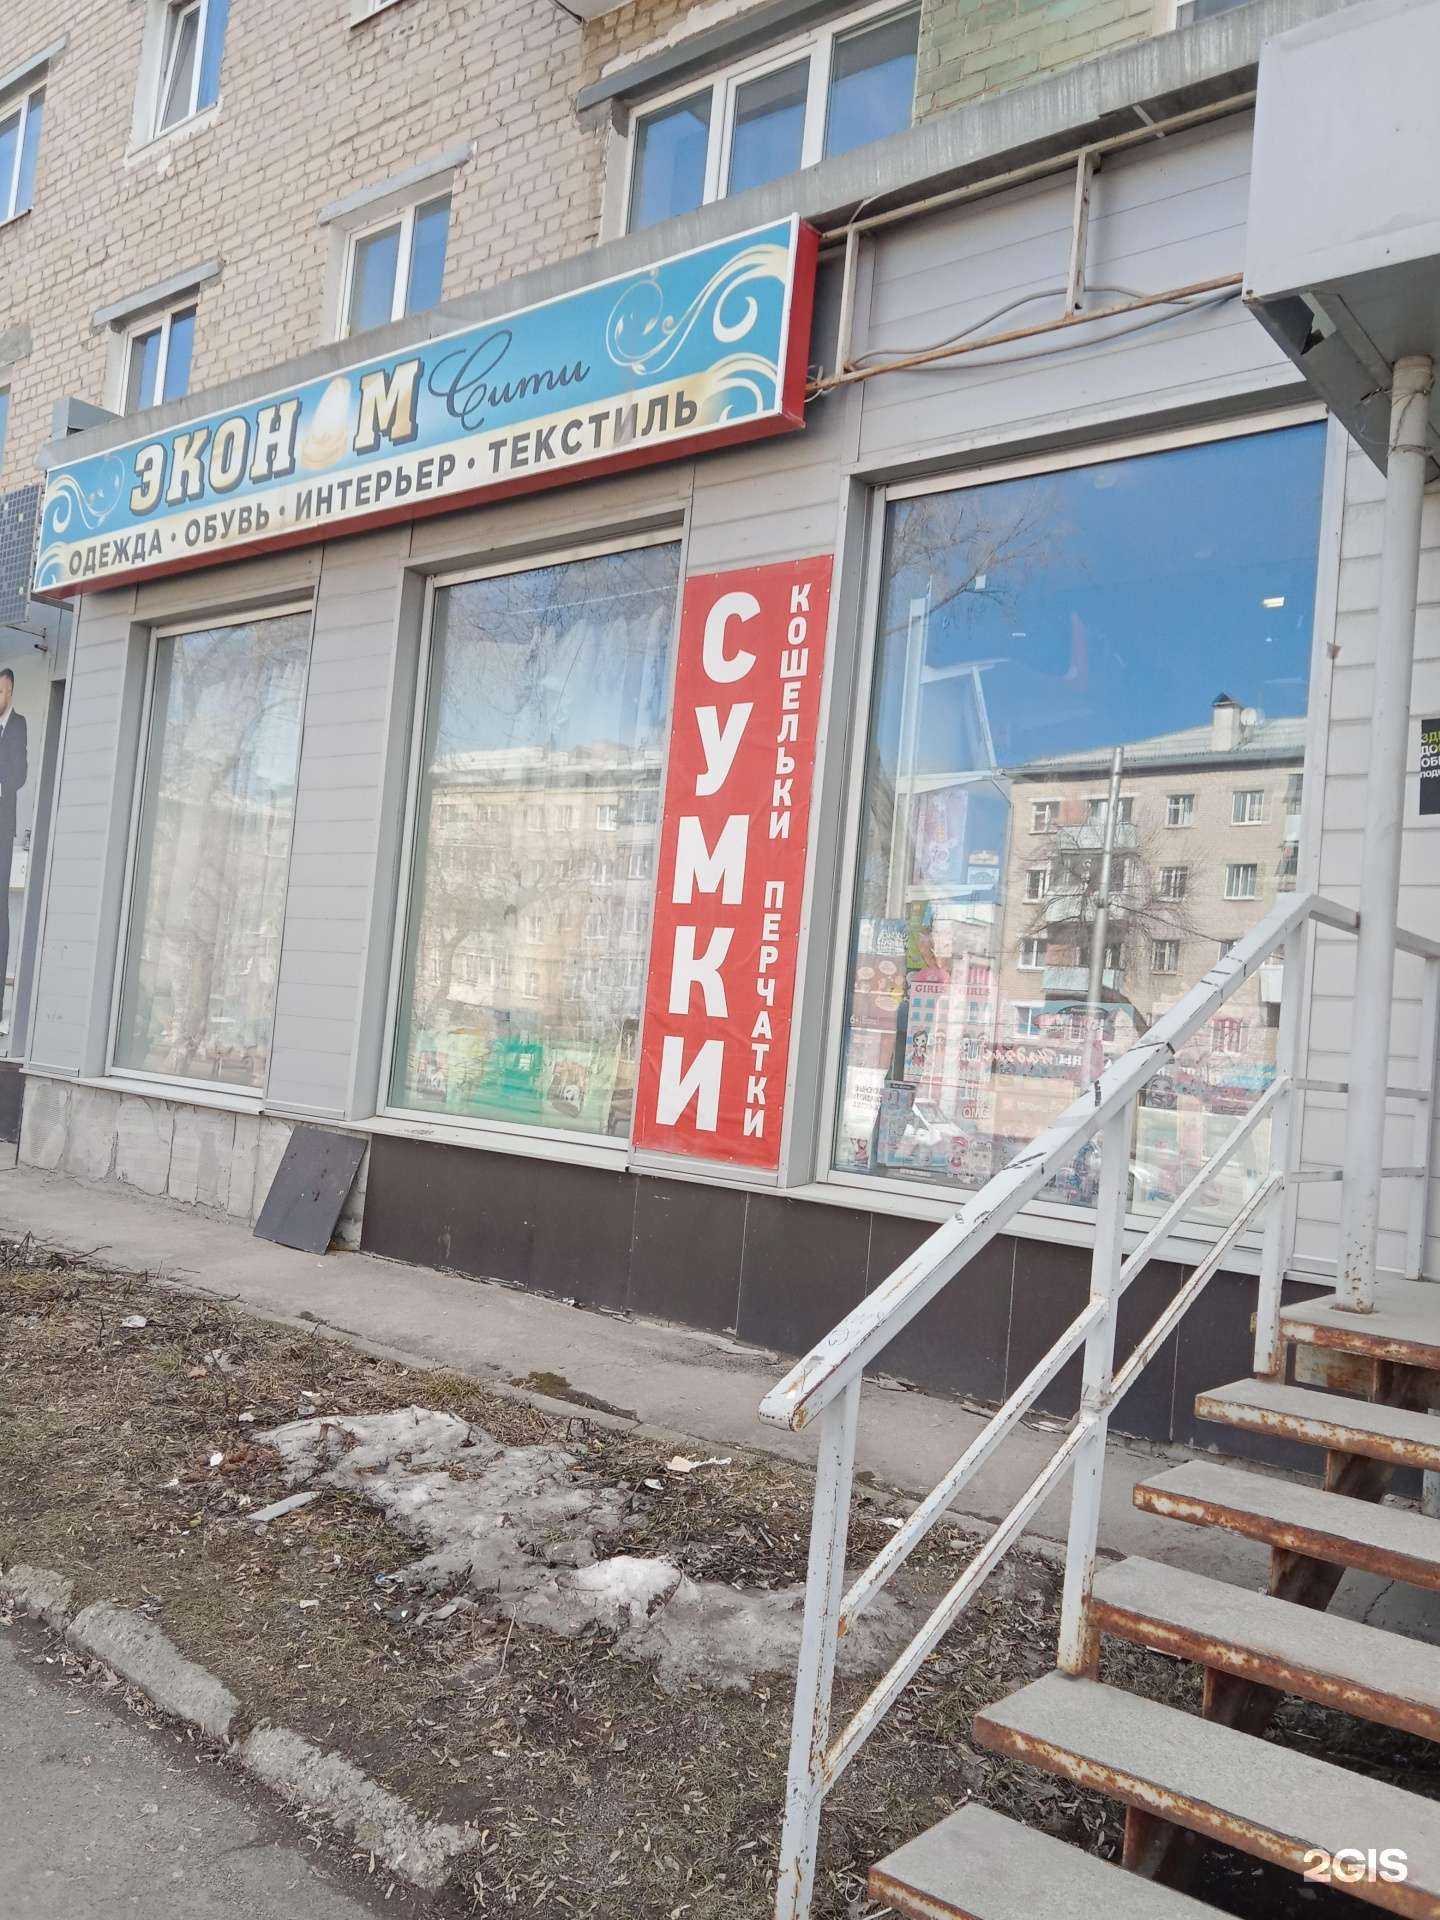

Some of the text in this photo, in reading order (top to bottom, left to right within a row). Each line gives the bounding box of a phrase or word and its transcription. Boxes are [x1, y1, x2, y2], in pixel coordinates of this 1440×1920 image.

[428, 328, 590, 431] Сити
[69, 390, 698, 576] ОДЕЖДА ОБУВЬ ИНТЕРЬЕР ТЕКСТИЛЬ
[1420, 731, 1440, 744] ЗД
[1421, 756, 1440, 768] ОБ
[655, 591, 761, 1132] СУМКИ
[743, 583, 812, 1138] КОШЕЛЬКИ ПЕРЧАТКИ
